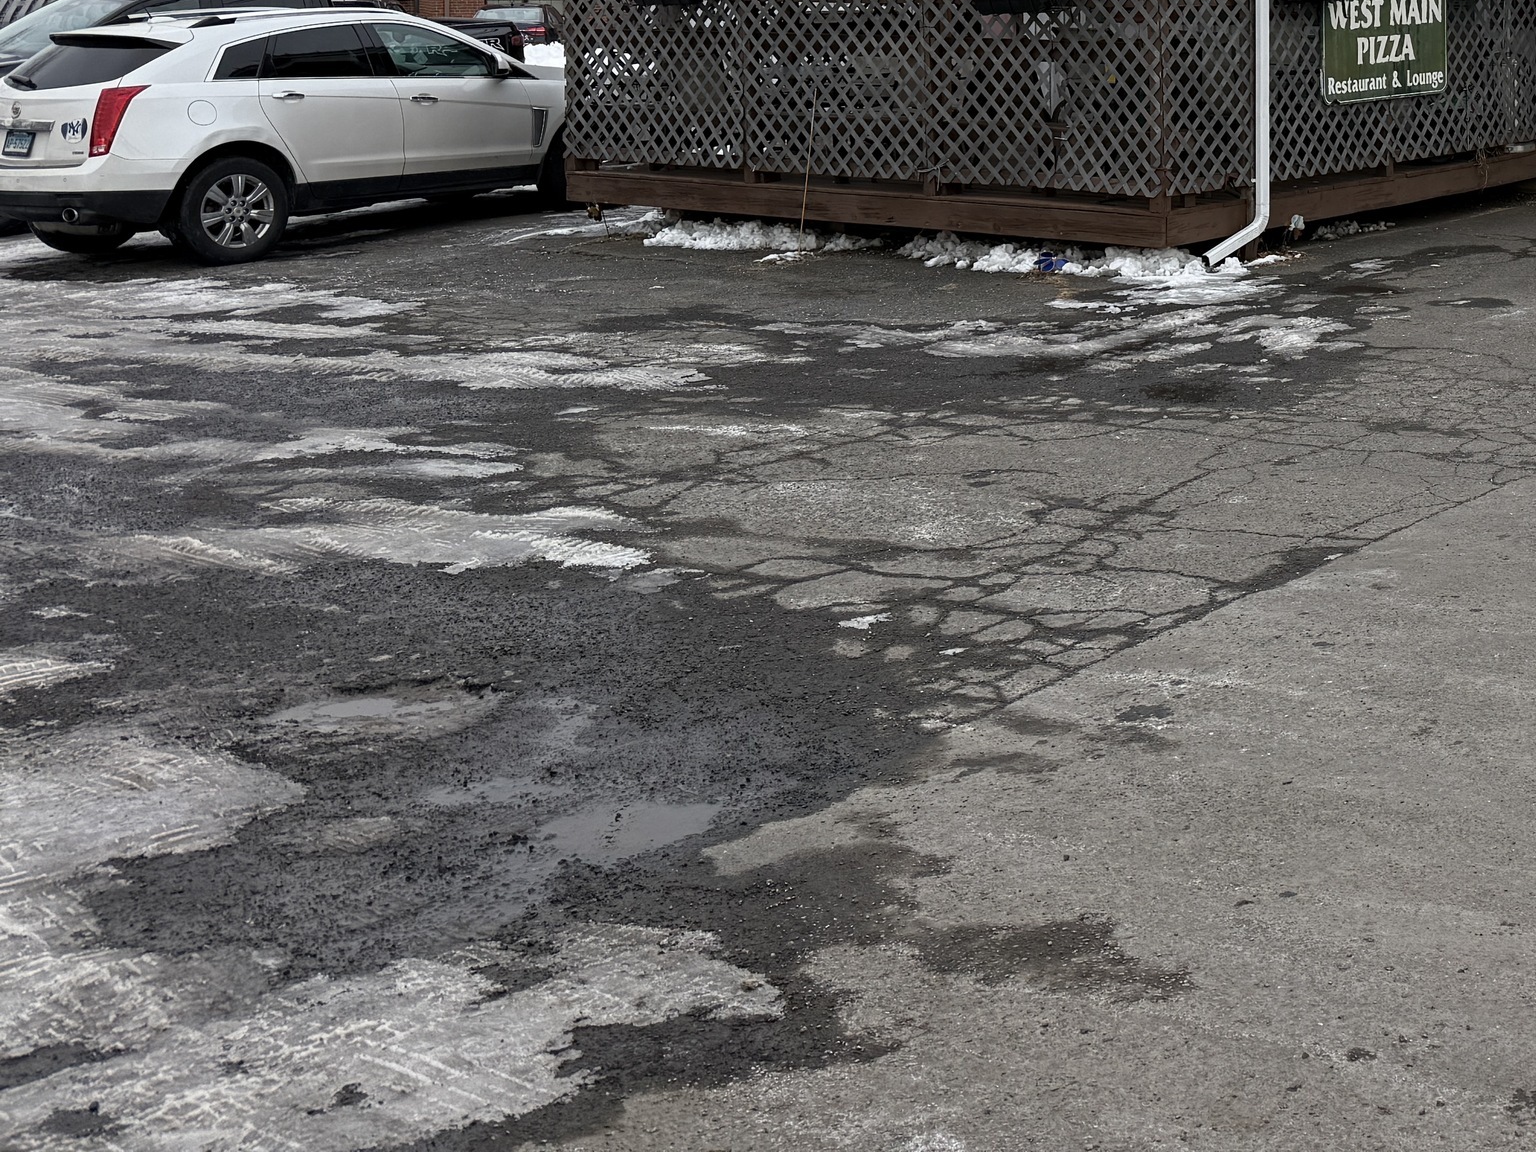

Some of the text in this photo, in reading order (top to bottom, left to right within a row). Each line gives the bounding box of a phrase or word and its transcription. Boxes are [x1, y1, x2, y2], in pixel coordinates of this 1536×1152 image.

[1357, 34, 1416, 65] PIZZA
[1327, 69, 1444, 95] Restaurant & Lounge
